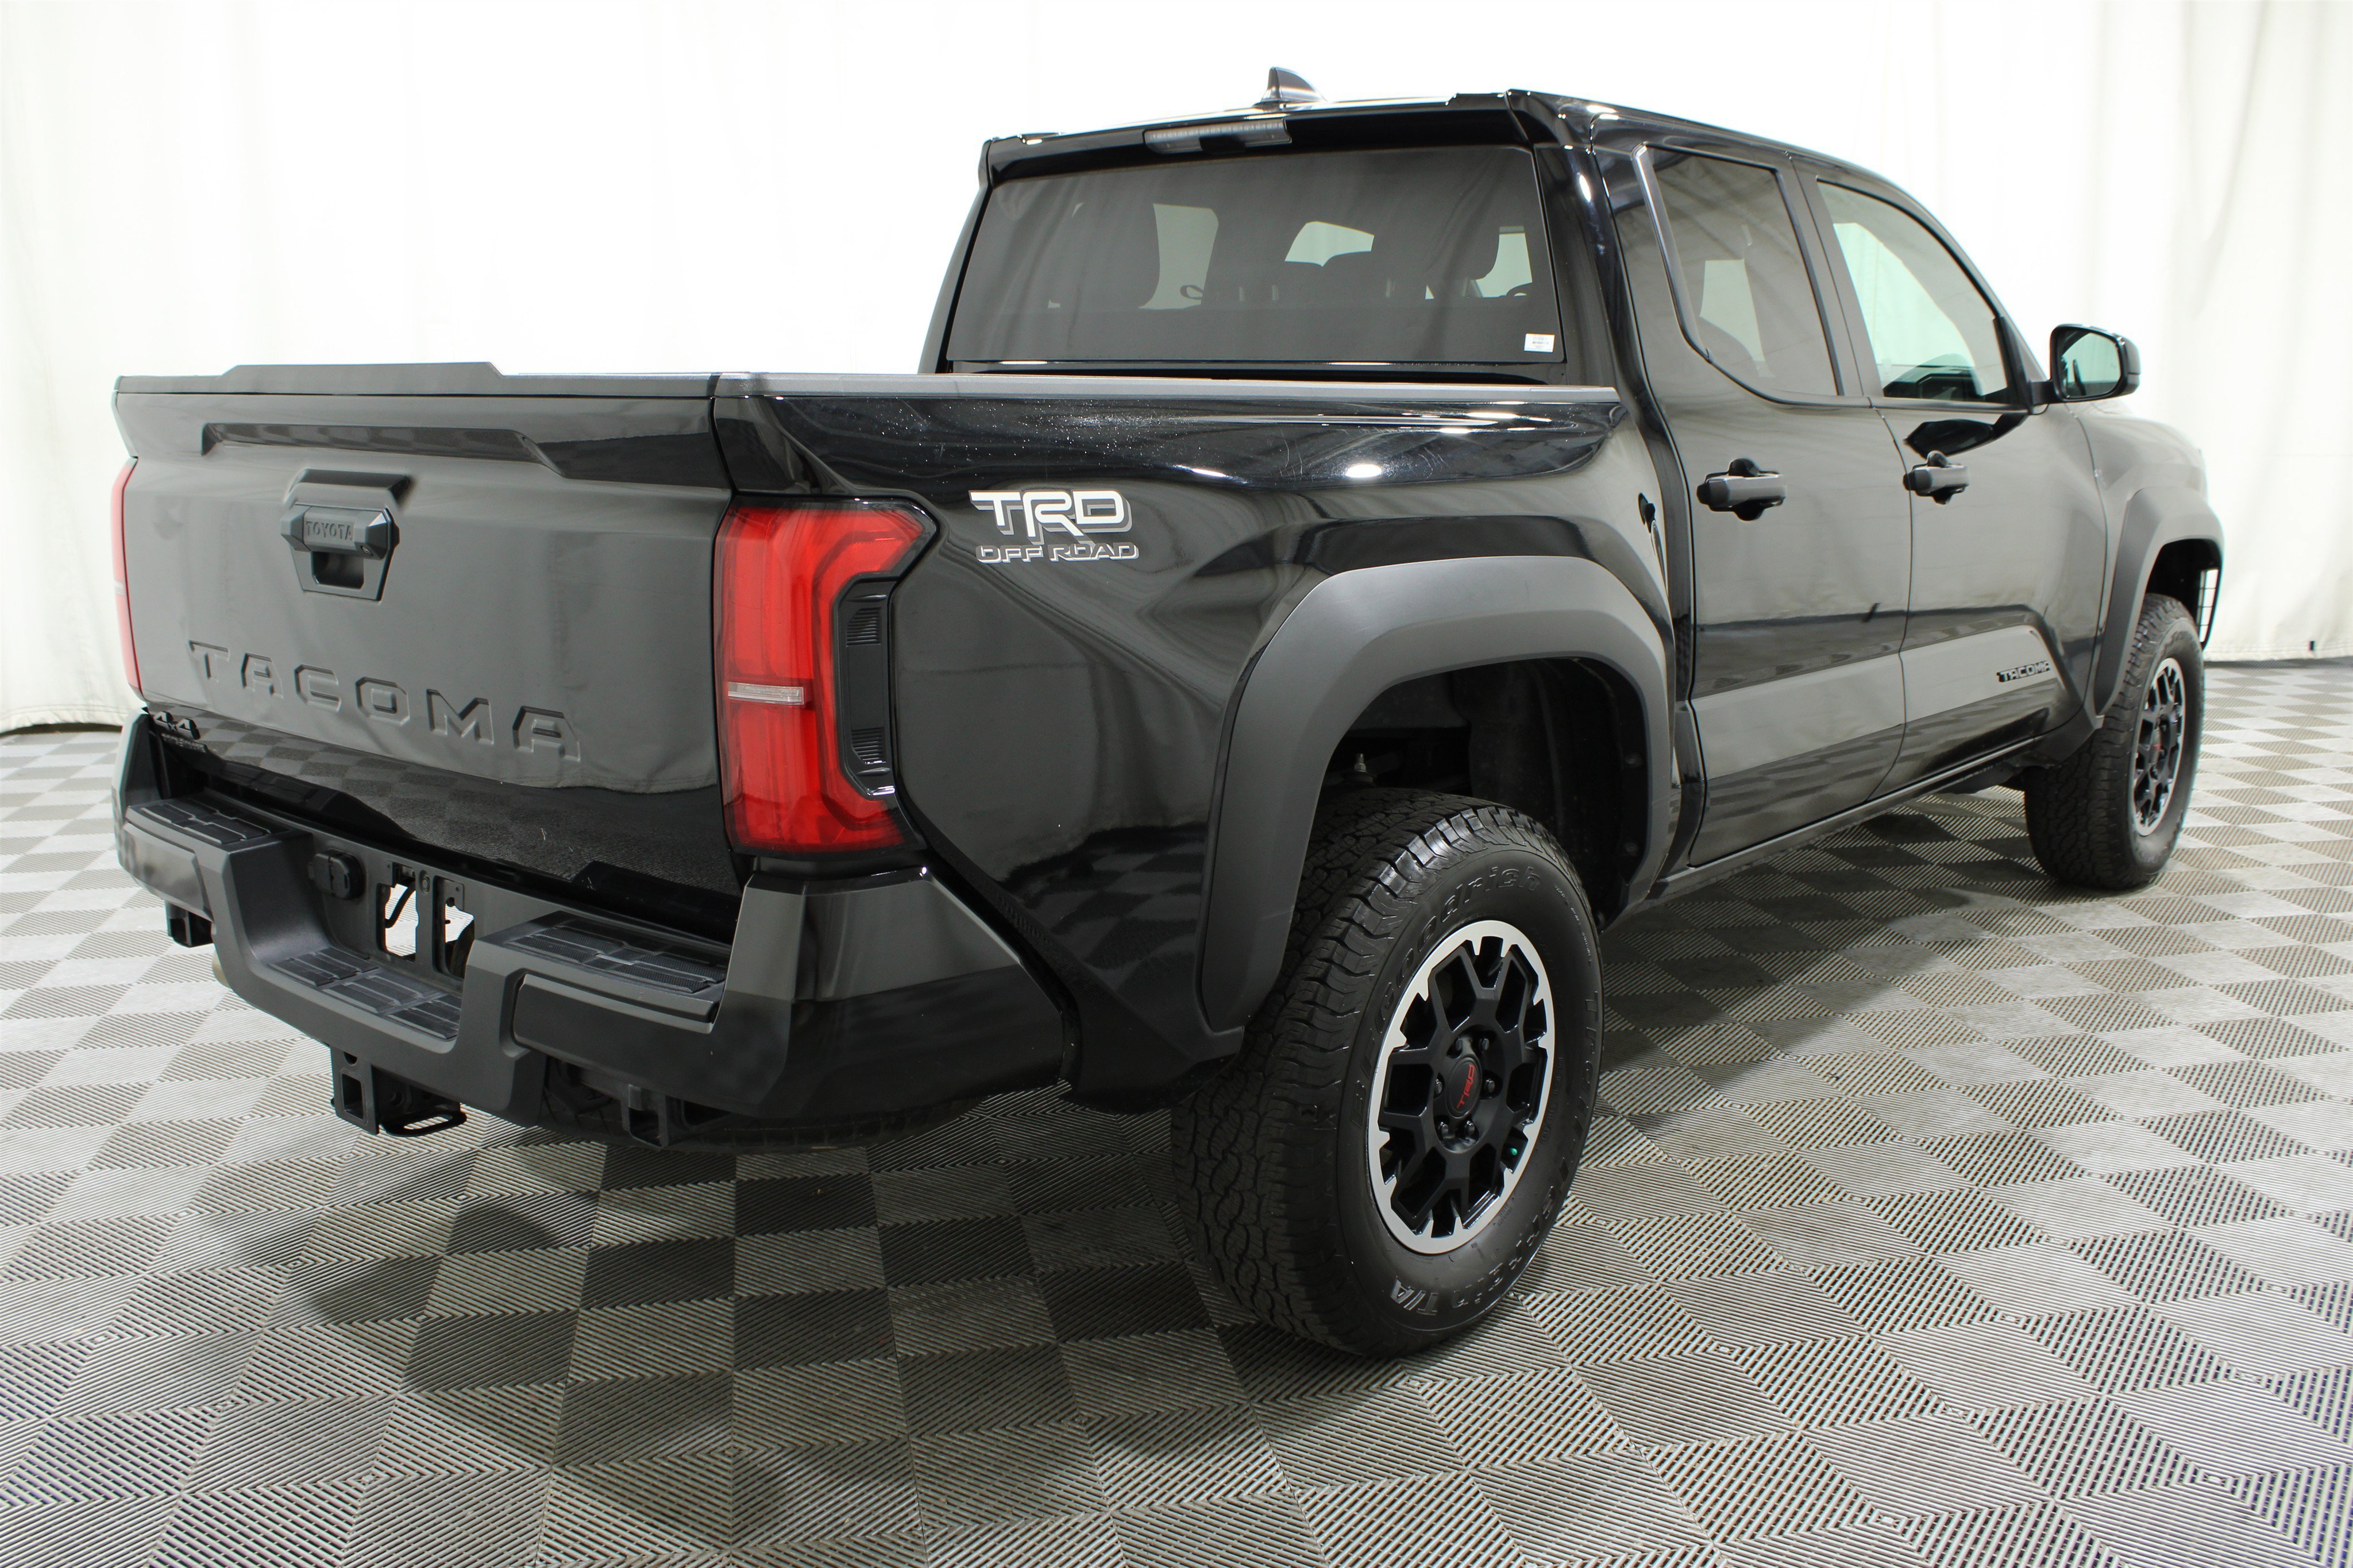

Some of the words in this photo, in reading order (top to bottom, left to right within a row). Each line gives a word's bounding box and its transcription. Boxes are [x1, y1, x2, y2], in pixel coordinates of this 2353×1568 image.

[306, 521, 353, 541] TOYOTA
[969, 490, 1132, 545] TRD
[976, 544, 1043, 563] OFF
[1048, 542, 1139, 562] ROAD
[1996, 660, 2051, 682] TACOMA
[188, 640, 581, 762] TACOMA
[1456, 1064, 1475, 1109] TRD
[1390, 1276, 1438, 1316] T/A
